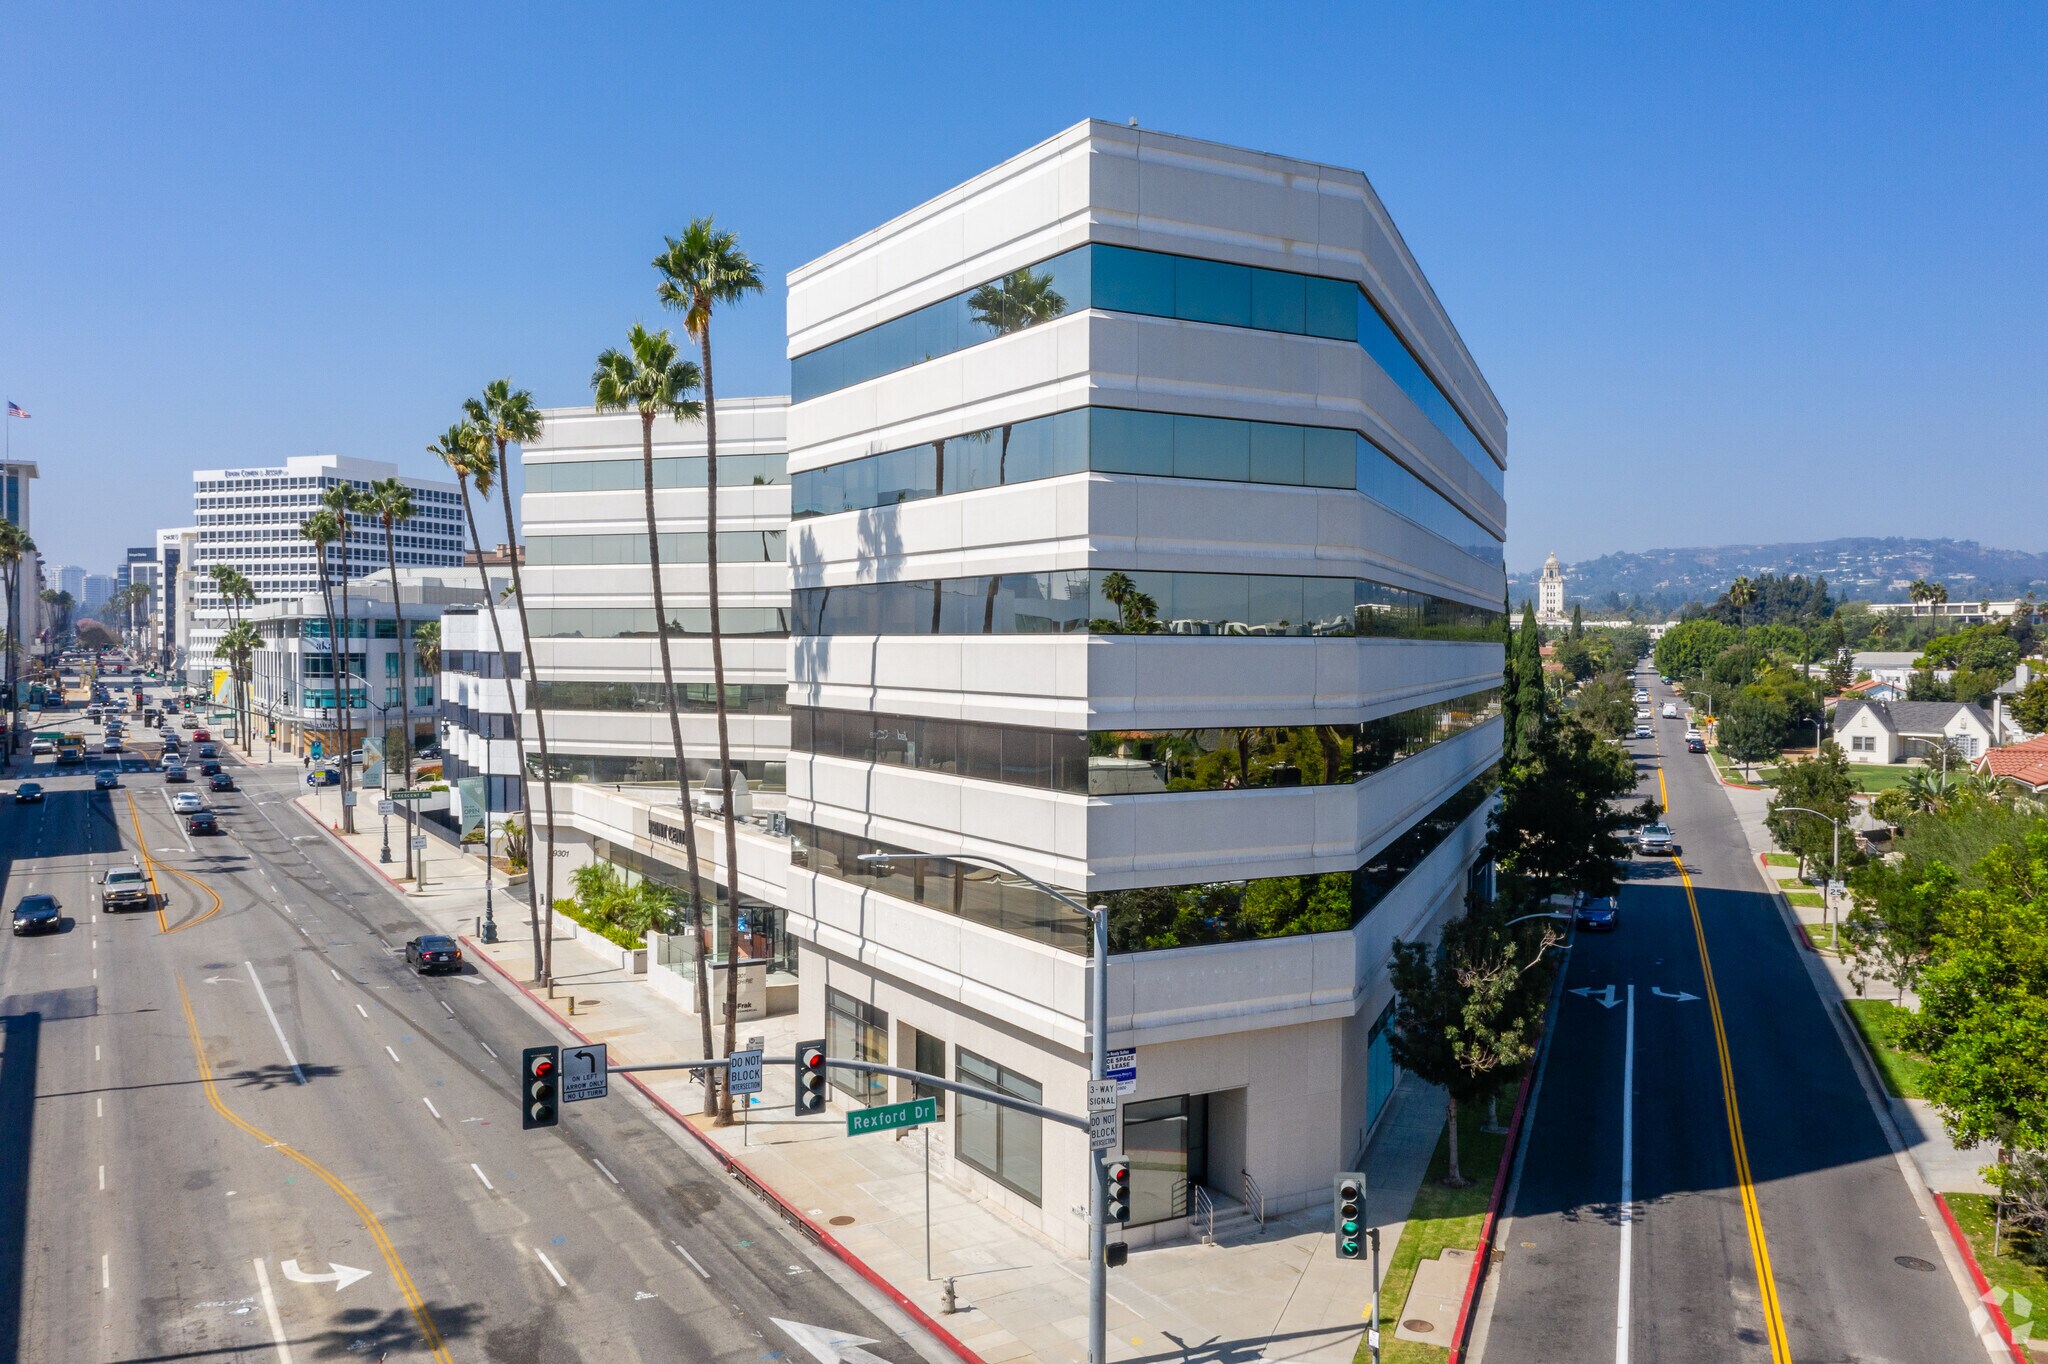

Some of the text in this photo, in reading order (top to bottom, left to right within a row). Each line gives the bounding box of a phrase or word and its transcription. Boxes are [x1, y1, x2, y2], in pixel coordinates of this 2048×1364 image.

[732, 1055, 760, 1068] DO NOT
[1116, 1055, 1134, 1063] SPACE
[732, 1069, 760, 1081] BLOCK
[566, 1082, 586, 1091] ARROW
[731, 1081, 760, 1090] INTERSECTION
[1090, 1085, 1114, 1094] 3-WAY
[1090, 1097, 1115, 1105] SIGNAL
[854, 1106, 929, 1130] Rexford Dr
[1092, 1115, 1114, 1126] DO NOT
[1092, 1127, 1115, 1139] BLOCK
[1092, 1138, 1115, 1147] INTERSECTION
